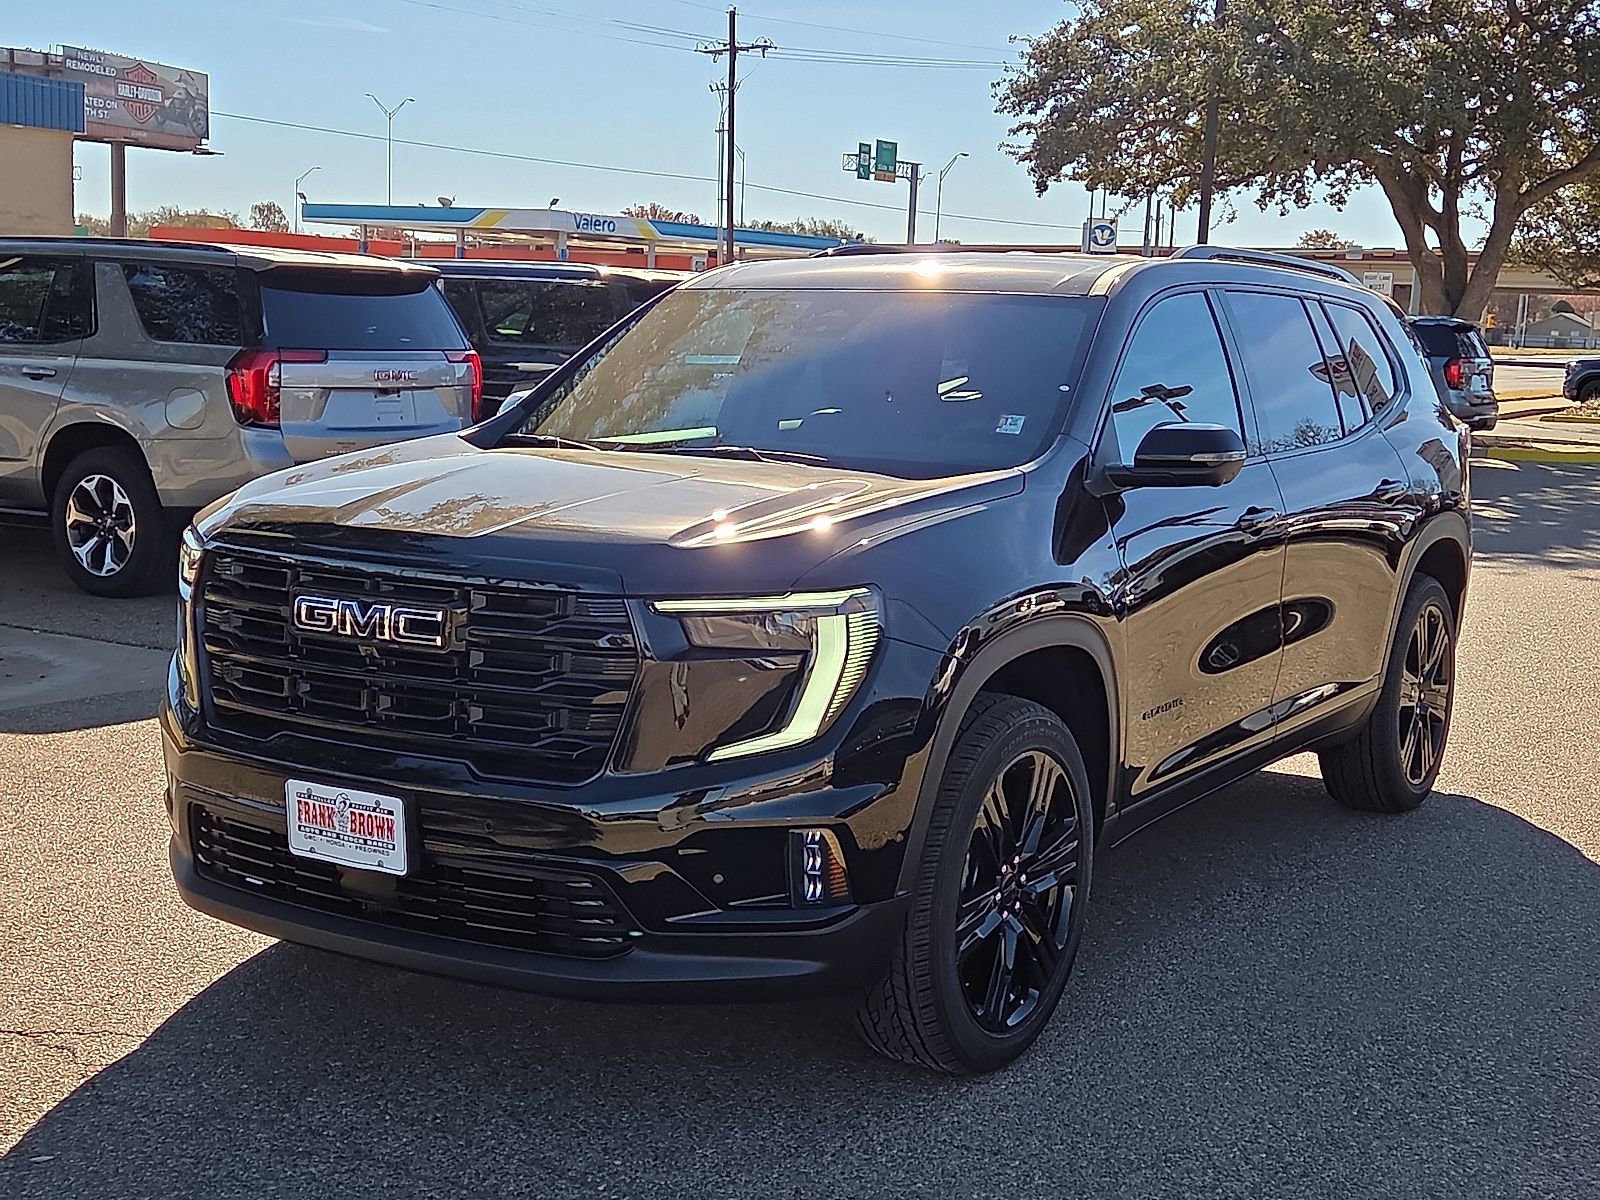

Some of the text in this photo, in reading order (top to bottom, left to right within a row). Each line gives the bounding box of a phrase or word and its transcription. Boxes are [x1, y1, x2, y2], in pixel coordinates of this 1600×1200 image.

[77, 51, 104, 63] NEWLY
[65, 58, 117, 77] REMODELED
[105, 100, 118, 110] ON
[573, 213, 616, 233] Valero
[374, 369, 419, 381] GMC
[294, 595, 443, 647] GMC
[296, 799, 395, 843] FRANK BROWN
[300, 825, 320, 835] AUTO
